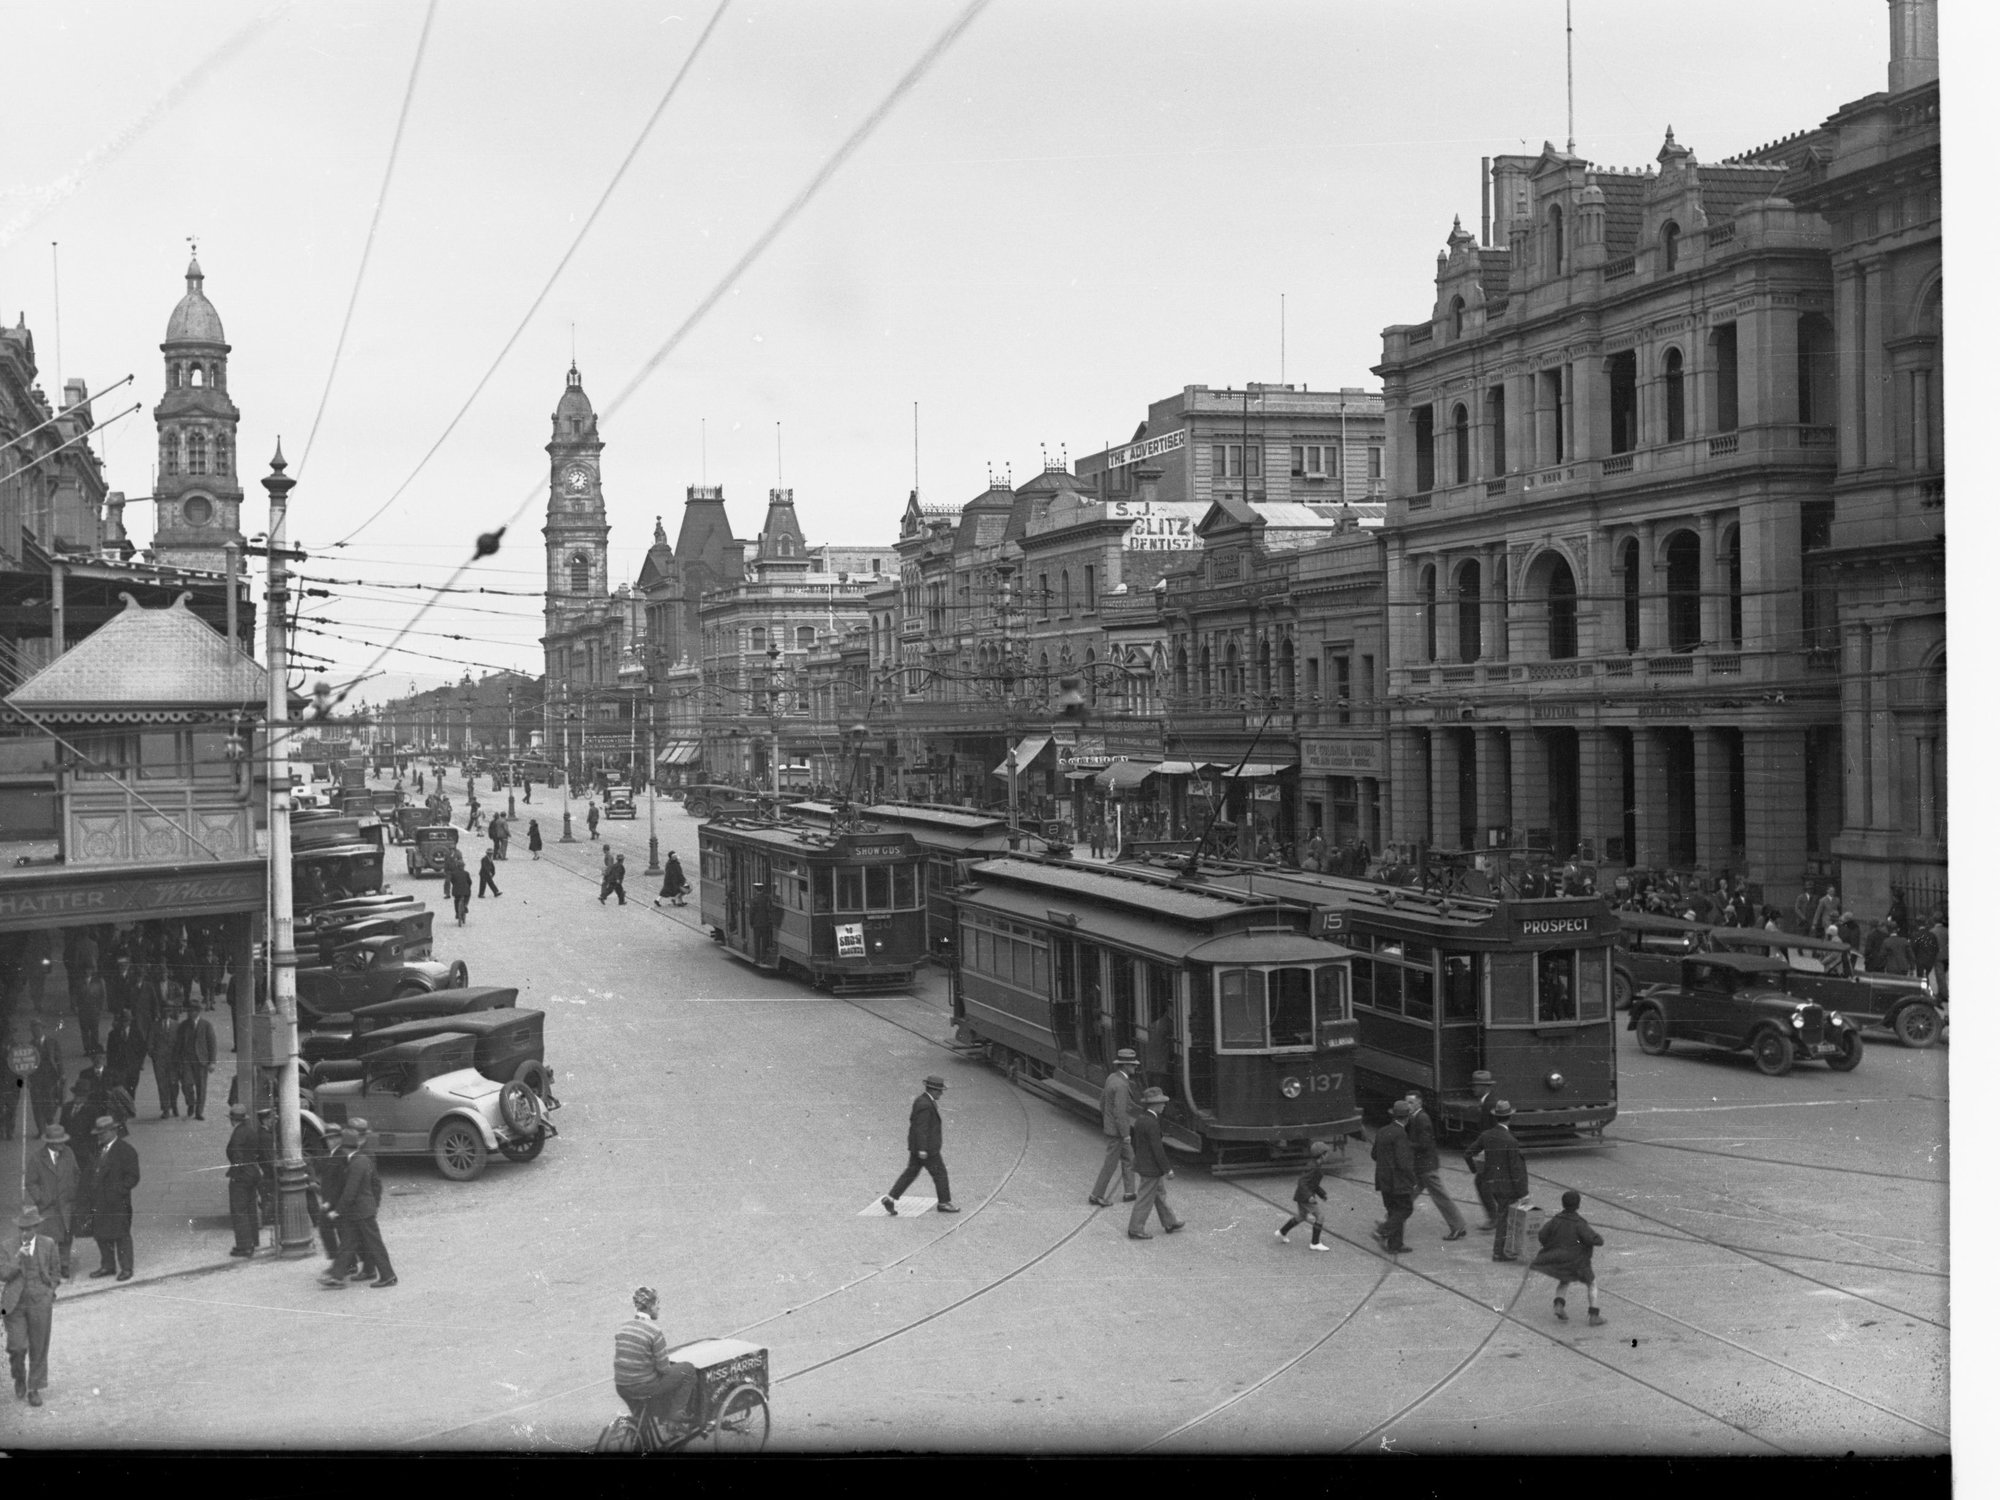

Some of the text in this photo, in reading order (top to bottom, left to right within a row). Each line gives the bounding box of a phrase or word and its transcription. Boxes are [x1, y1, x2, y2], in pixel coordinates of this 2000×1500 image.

[1109, 431, 1185, 467] THE ADVERTISER
[1115, 501, 1133, 516] S.
[1130, 537, 1190, 550] DENTIST
[856, 846, 880, 857] SHOW
[0, 891, 105, 914] HATTER
[1323, 913, 1342, 930] 15
[1523, 918, 1589, 934] PROSPECT
[1310, 1072, 1344, 1092] 137
[706, 1366, 729, 1384] MISS
[730, 1358, 762, 1376] HARRIS
